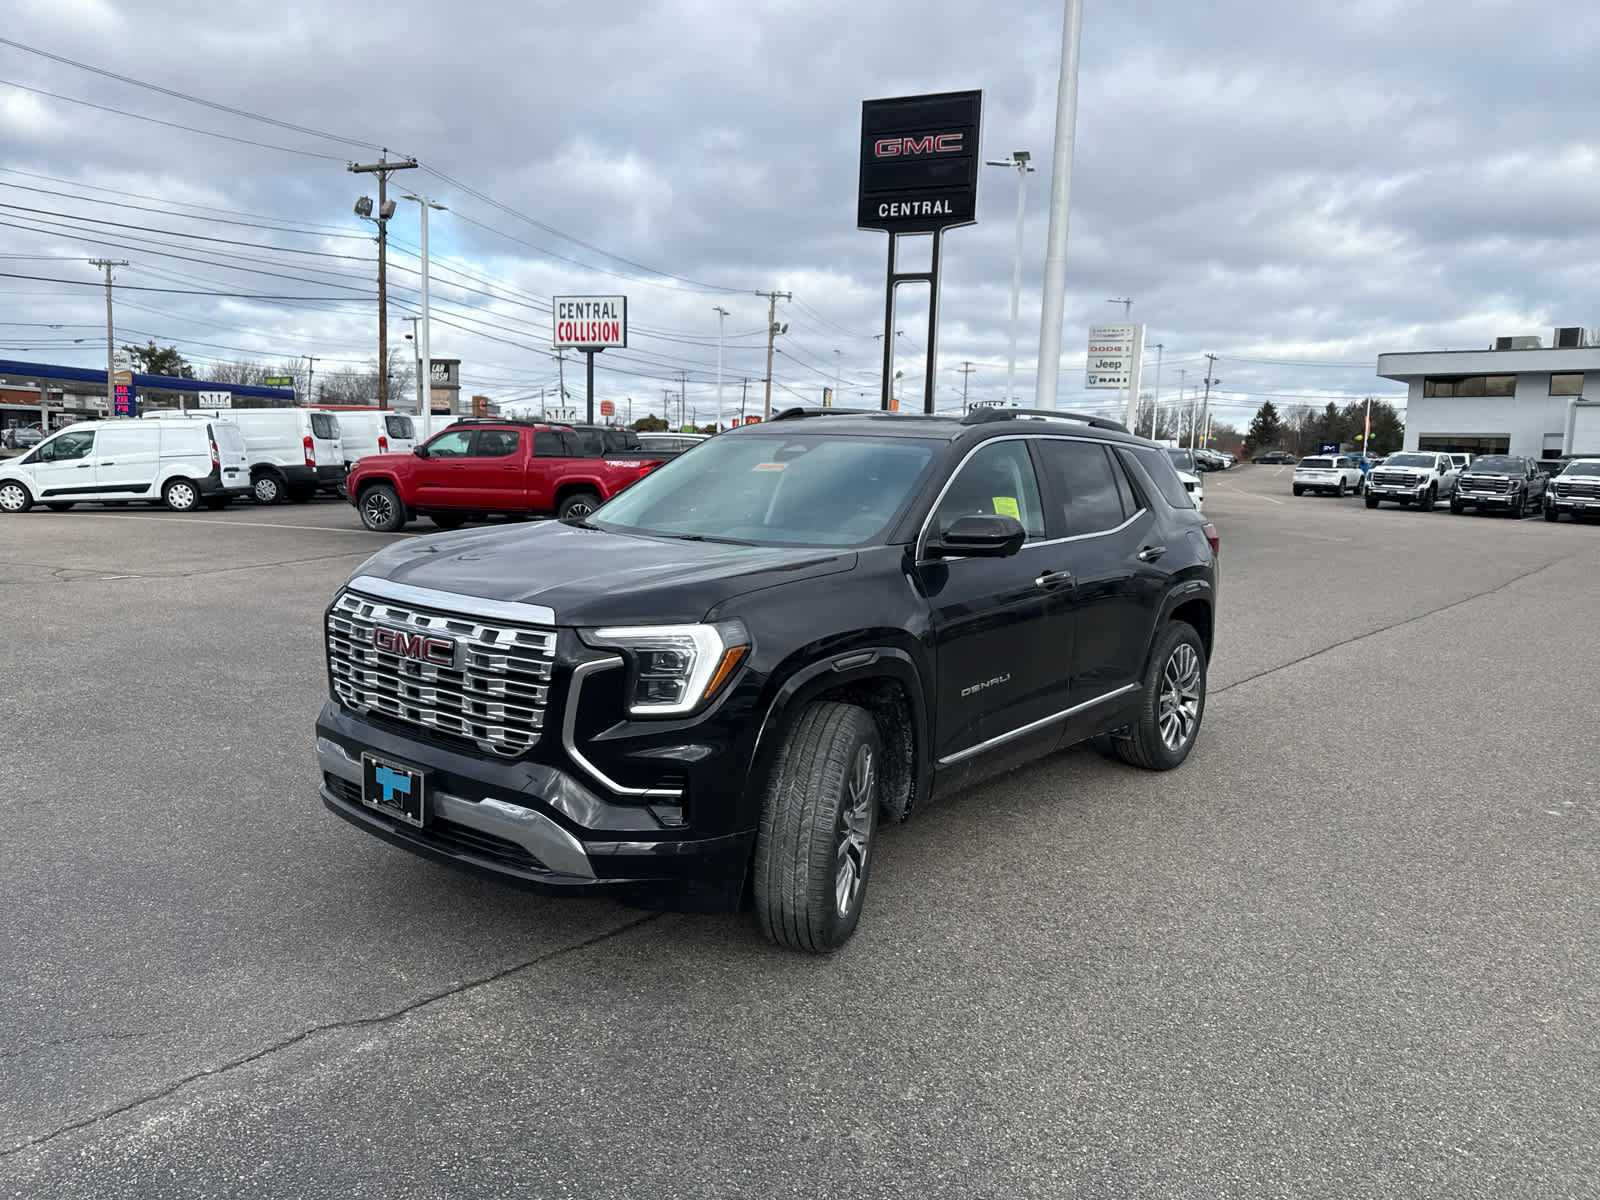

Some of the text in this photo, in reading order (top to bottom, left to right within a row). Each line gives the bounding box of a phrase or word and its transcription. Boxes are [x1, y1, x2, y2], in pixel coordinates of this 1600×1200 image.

[875, 133, 963, 157] GMC
[878, 200, 953, 217] CENTRAL
[559, 302, 618, 319] CENTRAL
[558, 321, 619, 342] COLLISION
[1095, 360, 1122, 370] Jeep
[374, 626, 454, 667] GMC
[960, 672, 1010, 697] DENALI
